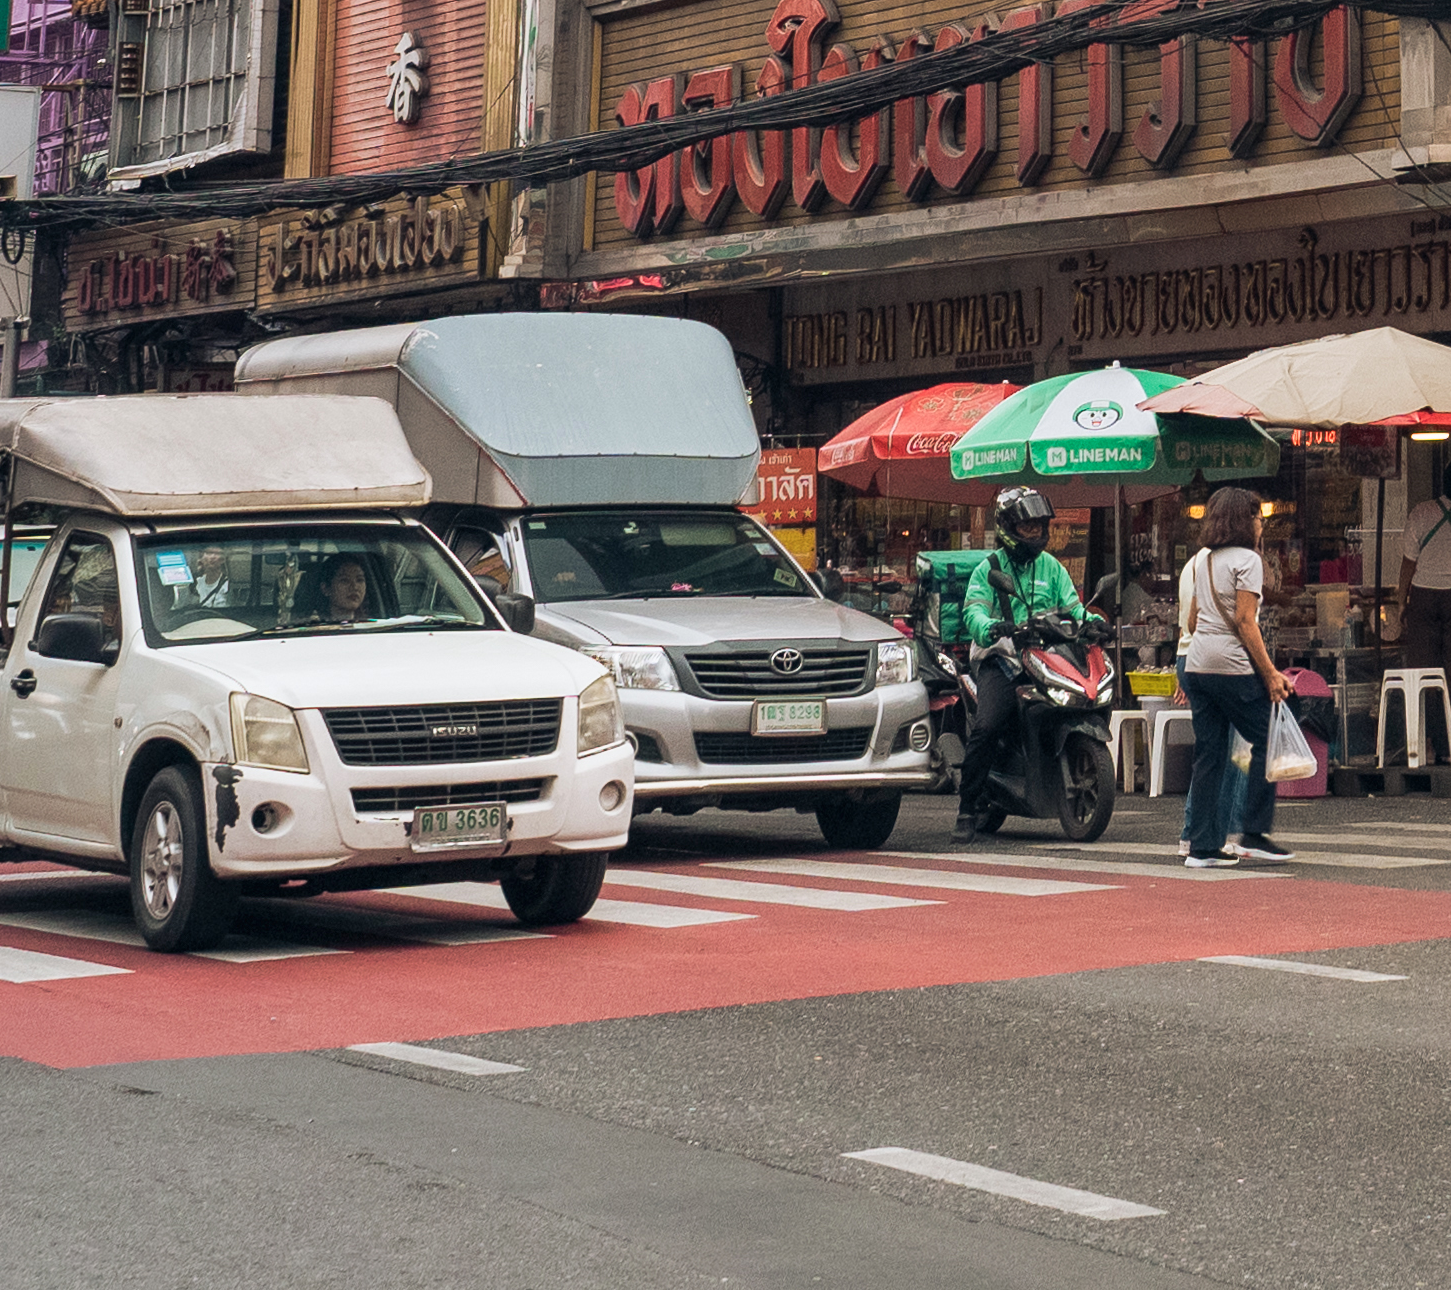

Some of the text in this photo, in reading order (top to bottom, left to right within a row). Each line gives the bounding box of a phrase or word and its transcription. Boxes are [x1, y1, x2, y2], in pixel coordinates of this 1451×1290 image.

[789, 309, 850, 369] TONG
[855, 304, 899, 364] BAI
[432, 725, 478, 738] ISUZU
[456, 807, 501, 830] 3636
